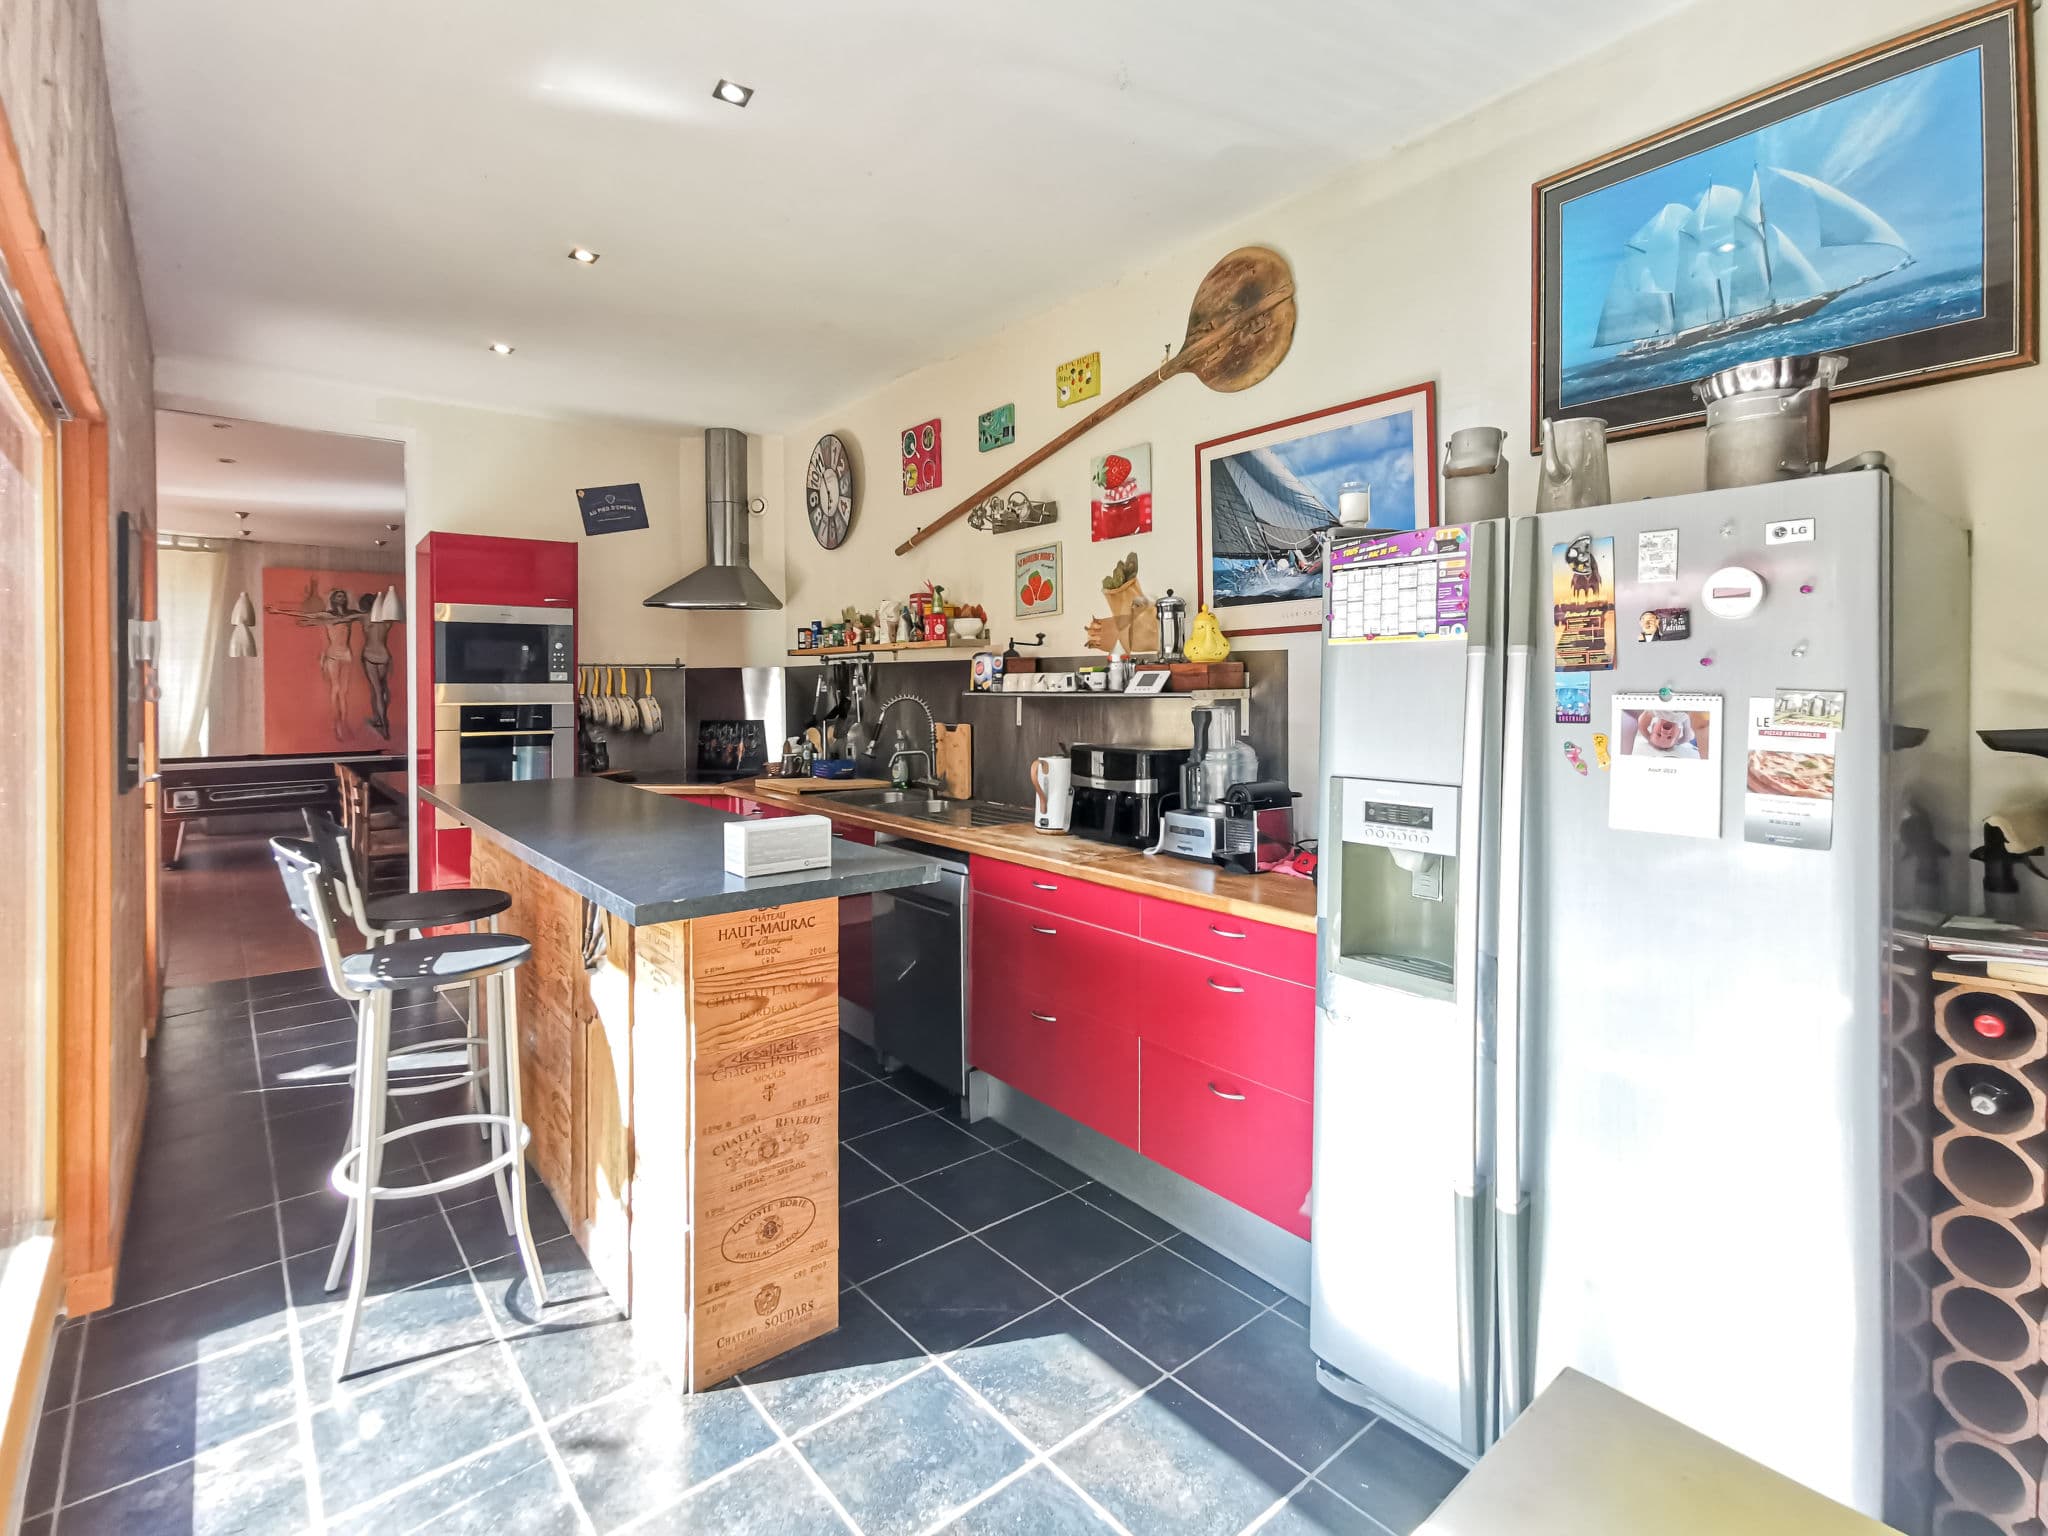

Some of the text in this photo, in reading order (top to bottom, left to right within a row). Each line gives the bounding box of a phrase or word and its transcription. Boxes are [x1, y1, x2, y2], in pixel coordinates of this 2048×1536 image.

[1791, 526, 1808, 535] LG
[717, 916, 817, 942] HAUT-MAURAC
[749, 911, 787, 924] CHÂTEAU
[731, 1203, 775, 1235] LACOSTE
[763, 1299, 816, 1330] SOUDARS
